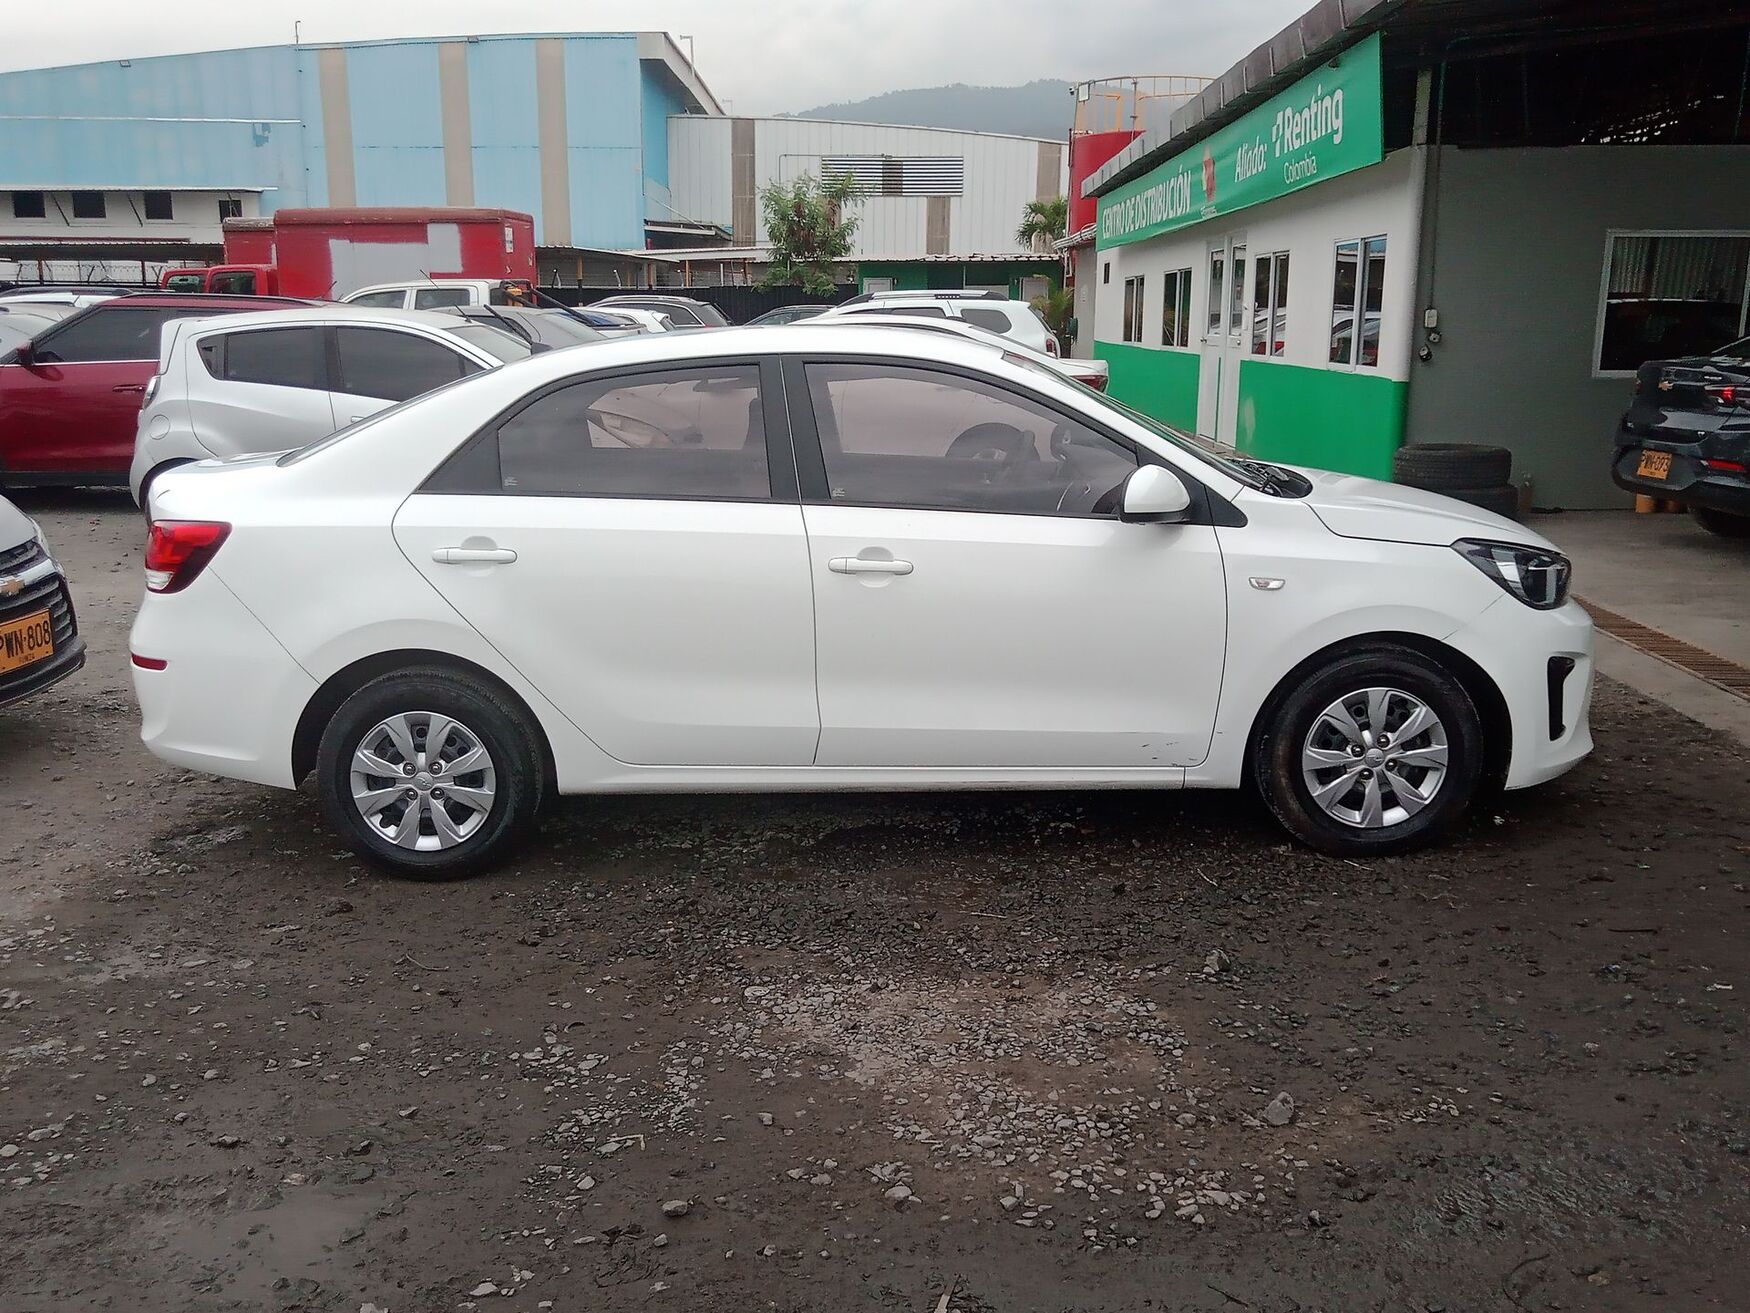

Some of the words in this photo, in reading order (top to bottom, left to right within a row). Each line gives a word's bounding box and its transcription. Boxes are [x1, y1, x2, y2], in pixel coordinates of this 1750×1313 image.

[1284, 84, 1344, 155] Renting
[1234, 135, 1268, 183] Aliado:
[1283, 155, 1317, 184] Colombia
[1102, 201, 1125, 240] CENTRO
[1125, 196, 1135, 234] DE
[1134, 164, 1191, 231] DISTRIBUCIÓN
